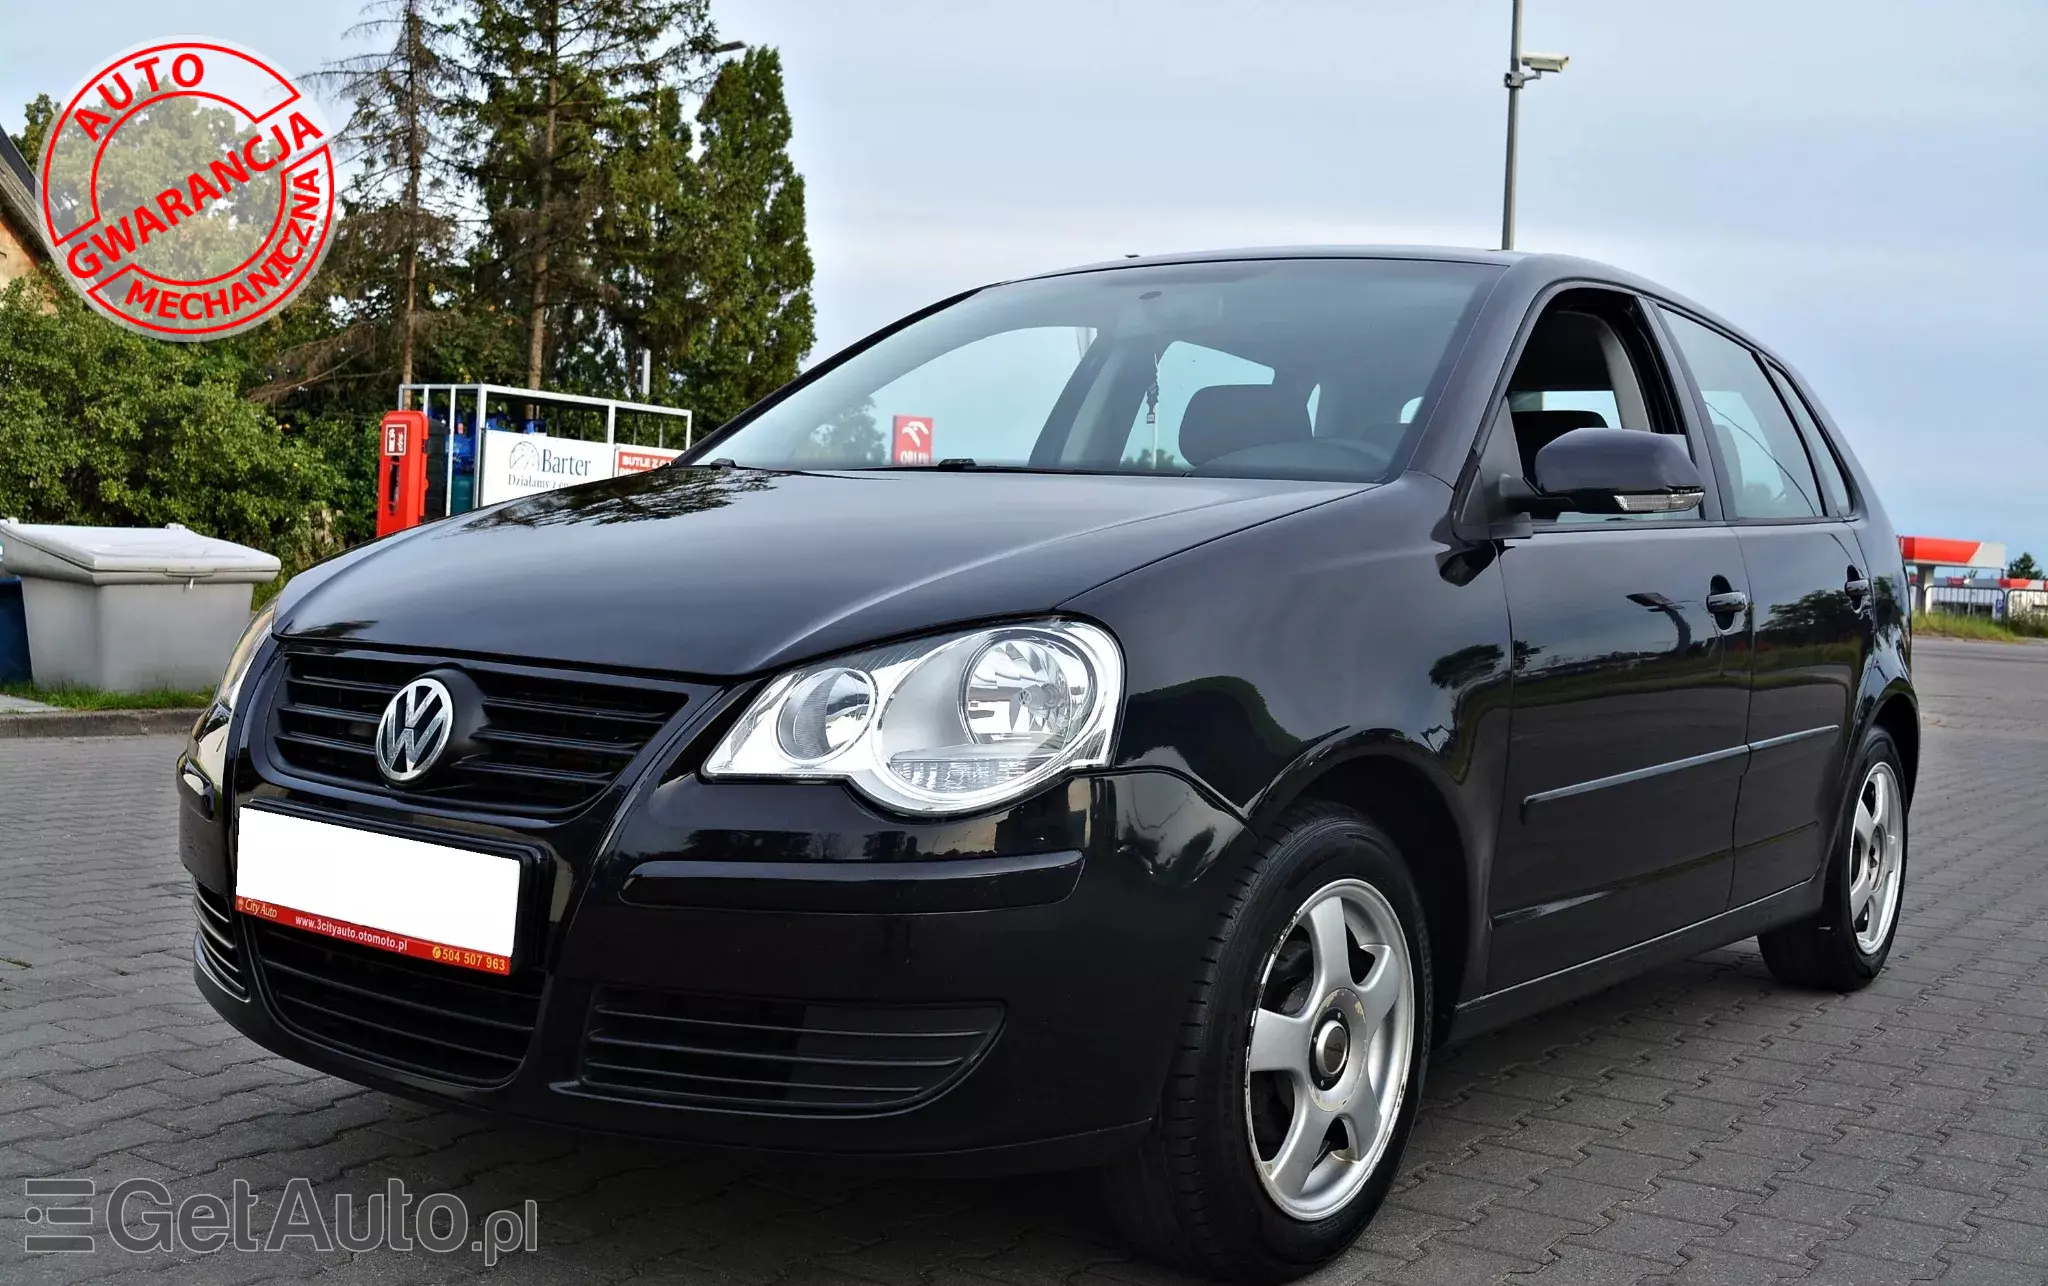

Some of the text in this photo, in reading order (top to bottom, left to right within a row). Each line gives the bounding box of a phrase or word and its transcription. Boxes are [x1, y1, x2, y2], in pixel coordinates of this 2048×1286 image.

[542, 448, 591, 476] Barter
[622, 455, 650, 467] BUTLE
[245, 899, 277, 918] City Auto
[295, 915, 408, 952] www.3cityauto.otomoto.pl
[442, 949, 505, 970] 504 507 963
